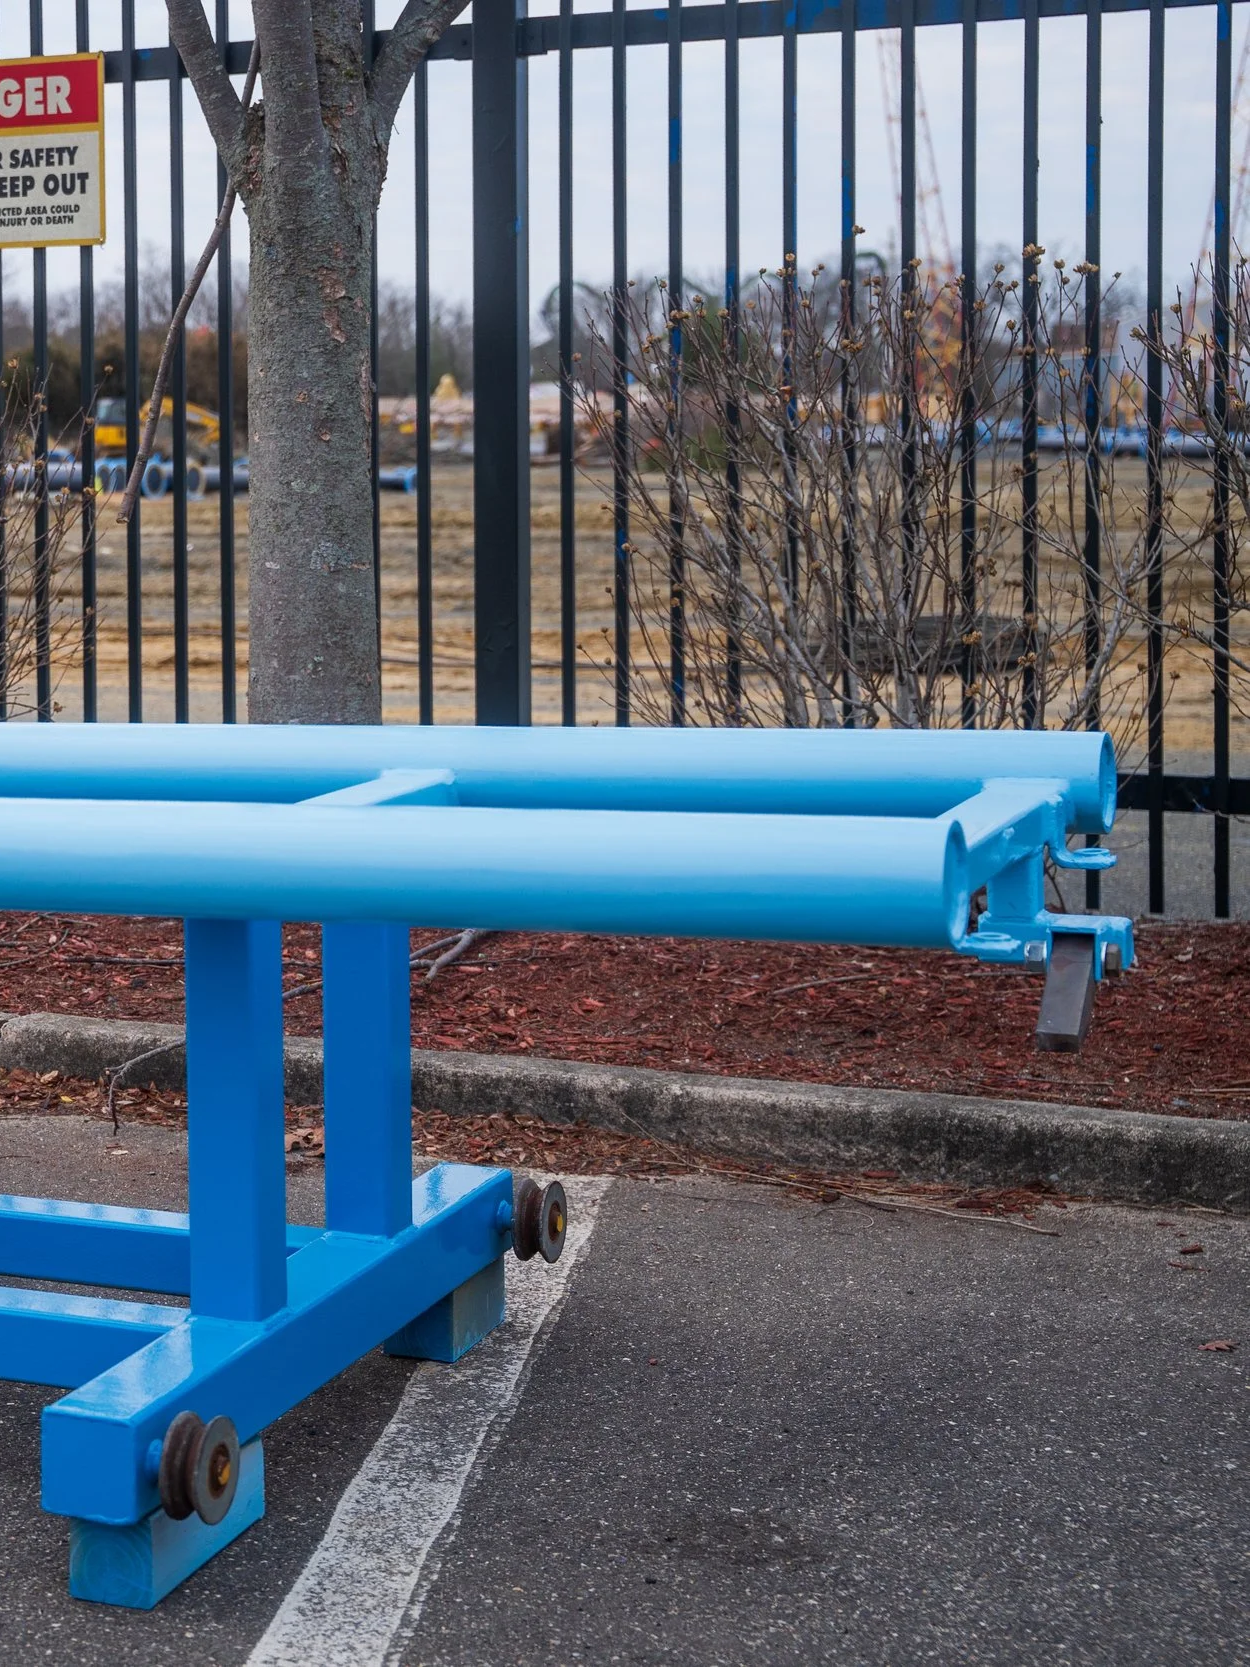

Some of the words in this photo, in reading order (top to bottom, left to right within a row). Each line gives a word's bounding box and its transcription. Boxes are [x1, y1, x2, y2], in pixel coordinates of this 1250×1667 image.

[9, 146, 78, 169] SAFETY
[43, 172, 89, 196] OUT
[25, 206, 47, 215] AREA
[50, 205, 80, 214] COULD
[31, 216, 42, 225] OR
[46, 215, 74, 225] DEATH
